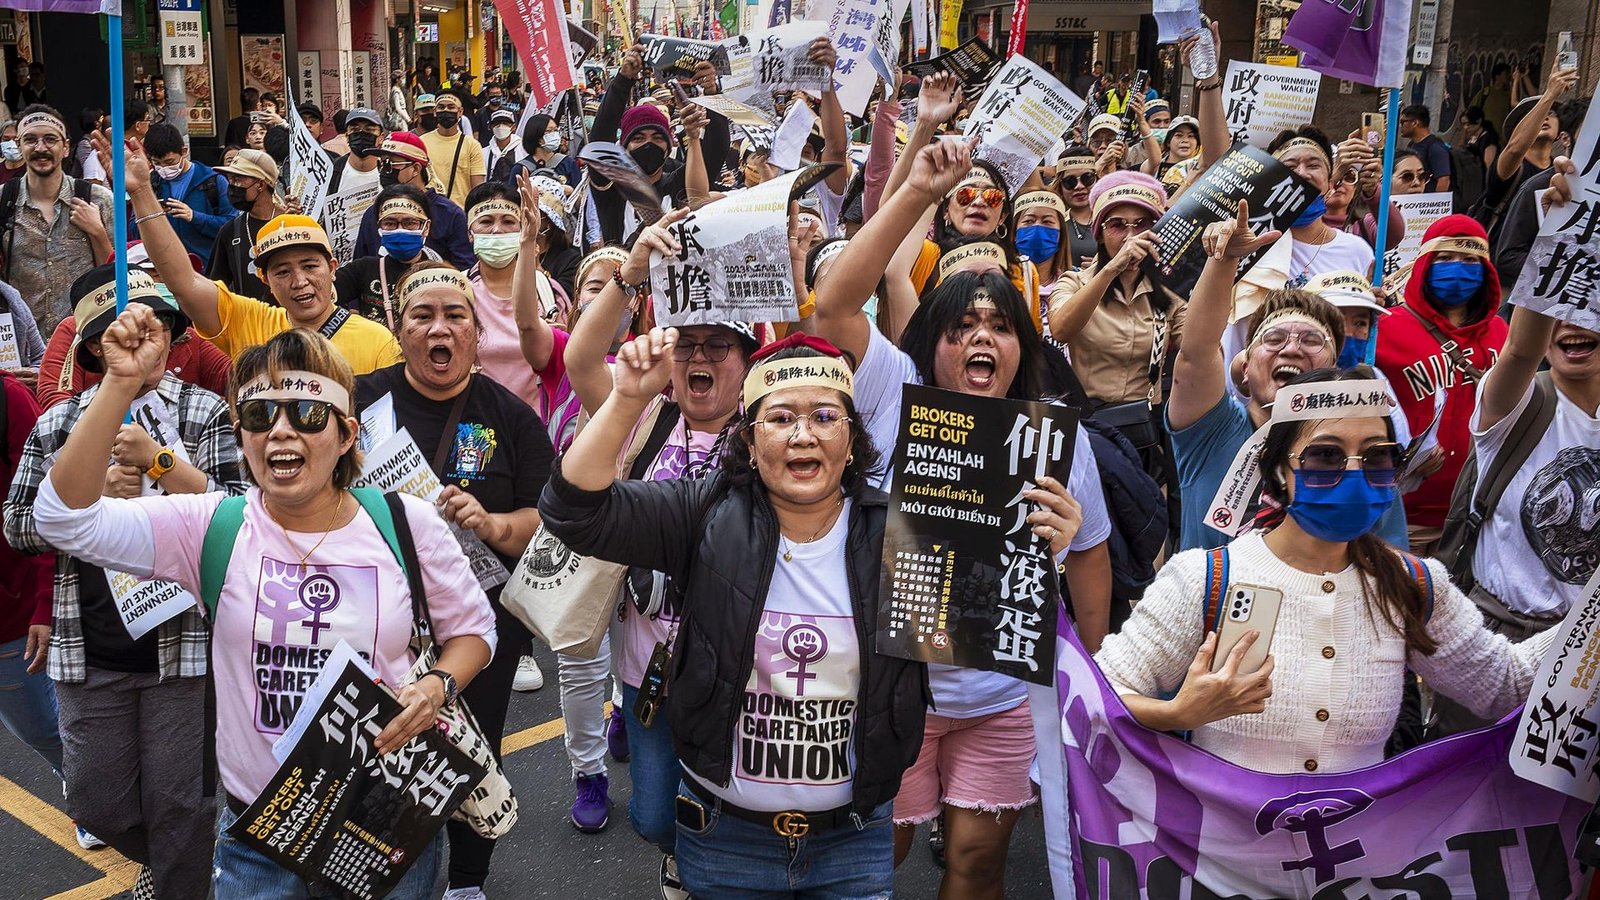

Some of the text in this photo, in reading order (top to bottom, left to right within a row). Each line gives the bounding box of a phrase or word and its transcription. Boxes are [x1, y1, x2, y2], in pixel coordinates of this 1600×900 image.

[1055, 17, 1088, 29] SST&C
[1263, 74, 1318, 87] GOVERNMENT
[1280, 84, 1317, 95] WAKE UP
[1033, 79, 1080, 116] GOVERNMENT
[1042, 96, 1074, 122] WAKE UP
[1222, 158, 1254, 179] GET OUT
[1229, 150, 1264, 174] BROKERS
[1206, 175, 1236, 195] AGENSI
[1213, 166, 1255, 196] ENYAHLAH
[1404, 201, 1451, 209] GOVERNMENT
[910, 405, 975, 430] BROKERS
[909, 422, 968, 446] GET OUT
[354, 441, 415, 489] OVERNMENT
[906, 443, 984, 470] ENYAHLAH
[378, 463, 411, 490] WAKE
[409, 454, 421, 469] UP
[903, 460, 961, 481] AGENSI
[899, 501, 1002, 528] MÔI GIỚI BIẾN ĐI
[121, 598, 134, 613] UP
[126, 585, 183, 625] VERNMENT
[1547, 582, 1600, 689] GOVERNME
[256, 668, 319, 693] CARET
[742, 691, 857, 721] DOMESTIC
[742, 715, 851, 742] CARETAKER
[741, 737, 850, 783] UNION
[246, 766, 303, 836] BROKERS
[256, 777, 306, 840] GET OUT
[266, 767, 327, 848] ENYAHLAH
[277, 798, 320, 854] AGENSI
